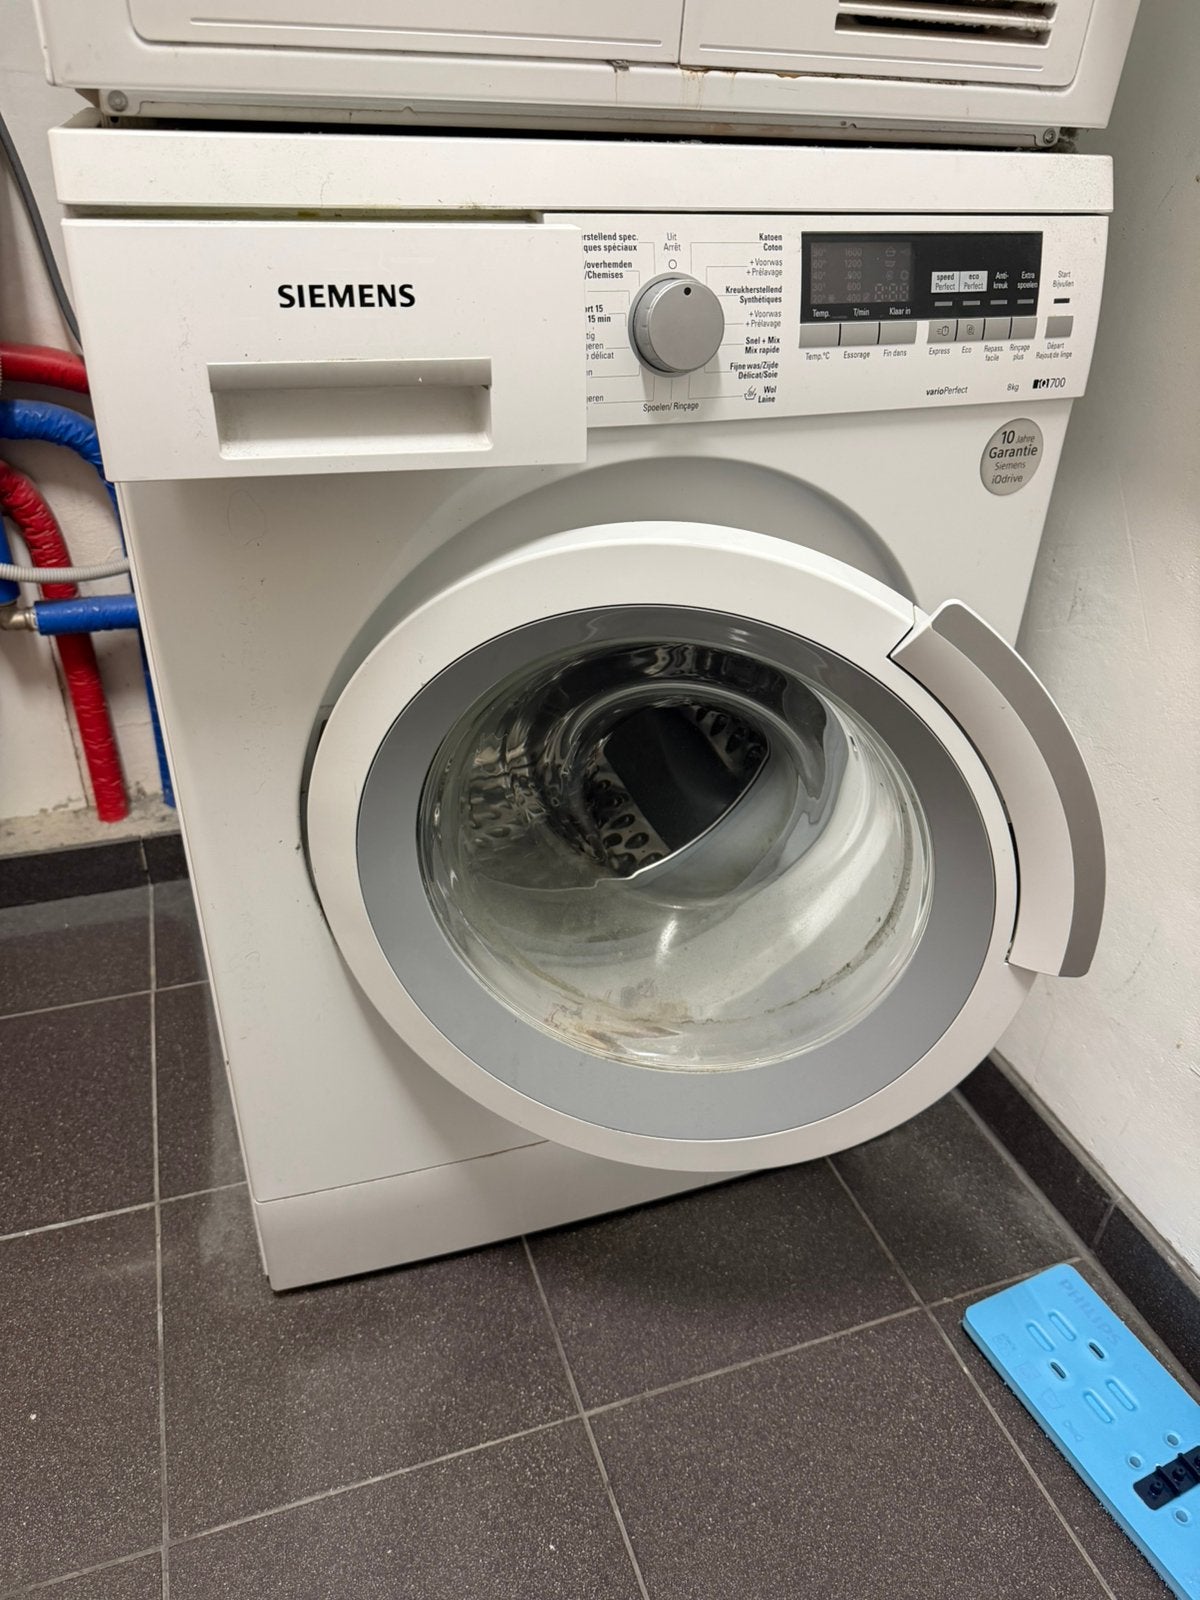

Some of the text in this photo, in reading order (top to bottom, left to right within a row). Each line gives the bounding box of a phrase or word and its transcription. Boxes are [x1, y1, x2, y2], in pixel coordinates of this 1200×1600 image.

[618, 234, 638, 242] spec.
[666, 232, 677, 241] Uit
[759, 233, 783, 241] Katoen
[603, 242, 638, 253] spéciaux
[663, 242, 681, 251] Arrêt
[763, 243, 783, 251] Coton
[584, 260, 632, 269] /overhemden
[584, 270, 624, 280] /Chemises
[936, 273, 955, 281] speed
[1021, 271, 1036, 279] Extra
[725, 286, 783, 294] Kreukherstellend
[935, 283, 956, 291] Perfect
[963, 282, 984, 291] Perfect
[277, 284, 416, 309] SIEMENS
[739, 295, 783, 304] Synthétiques
[595, 304, 603, 313] 15
[853, 308, 870, 316] T/min
[889, 306, 911, 315] Klaar in
[587, 313, 612, 323] 15 min
[812, 309, 830, 318] Temp.
[745, 337, 760, 345] Snel
[767, 336, 780, 344] Mix
[745, 346, 780, 355] Mix rapide
[929, 347, 950, 355] Express
[962, 346, 972, 354] Eco
[1010, 343, 1030, 352] Rinçage
[590, 351, 614, 360] délicat
[843, 351, 870, 360] Essorage
[883, 349, 892, 357] Fin
[985, 353, 1000, 361] facile
[1013, 353, 1024, 361] plus
[738, 371, 778, 380] Délicat/Soie
[764, 385, 777, 393] Wol
[926, 385, 969, 396] varioPerfect
[1007, 383, 1020, 392] 8kg
[758, 395, 776, 403] Laine
[673, 401, 700, 411] Rinçage
[1001, 430, 1036, 444] 10 Jahre
[988, 443, 1039, 460] Garantie
[994, 461, 1027, 471] Siemens
